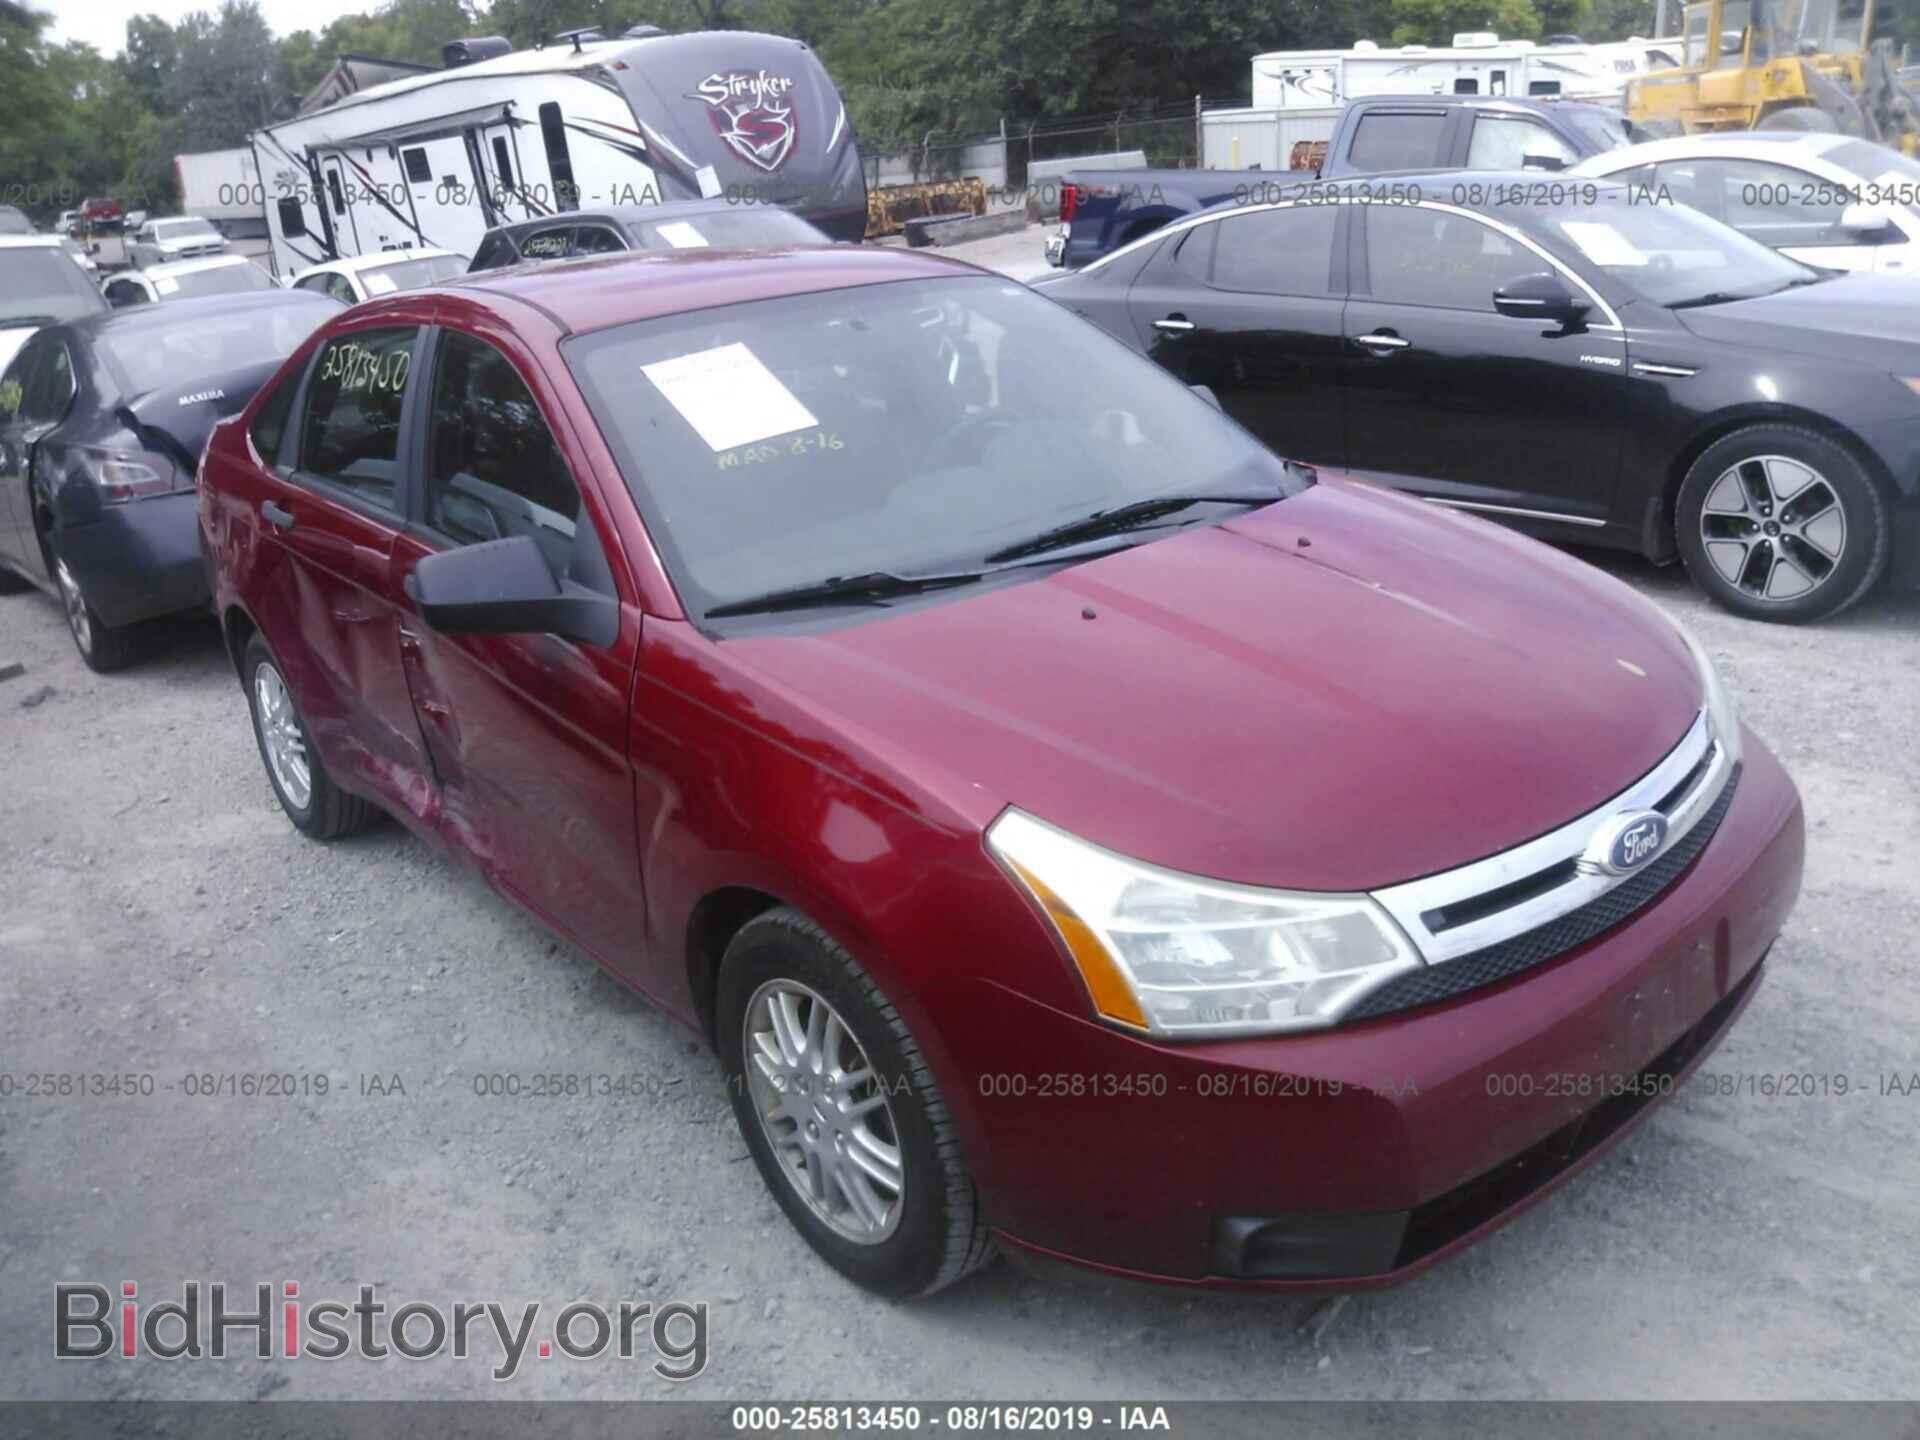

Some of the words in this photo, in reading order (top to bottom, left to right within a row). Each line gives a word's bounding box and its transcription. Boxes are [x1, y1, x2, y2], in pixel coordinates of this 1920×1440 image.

[686, 70, 793, 110] Stryker
[1579, 354, 1622, 367] HYBRID
[179, 389, 224, 406] MAXIMA
[1622, 823, 1658, 863] Ford
